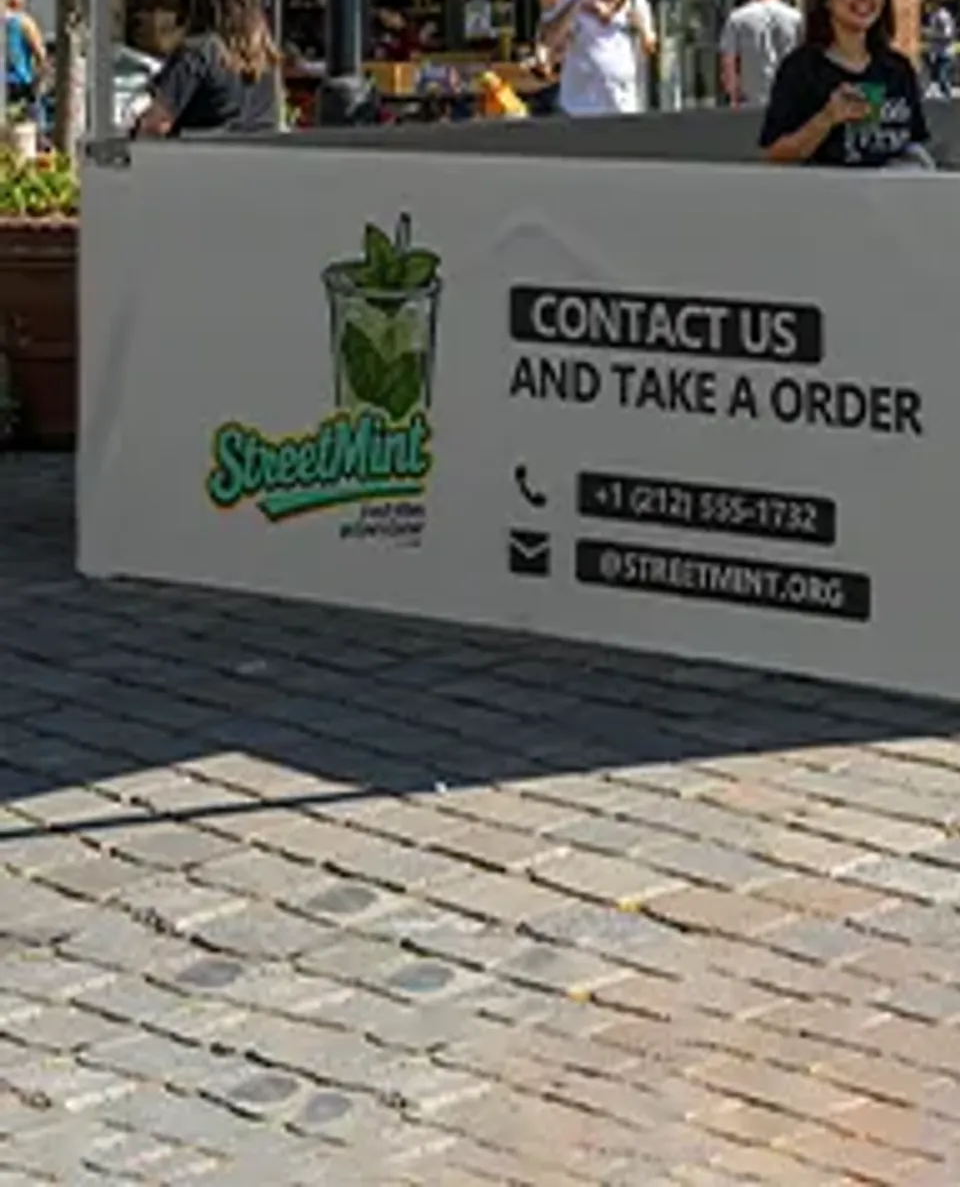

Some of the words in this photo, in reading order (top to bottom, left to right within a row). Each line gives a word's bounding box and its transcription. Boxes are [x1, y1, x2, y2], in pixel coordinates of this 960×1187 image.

[531, 295, 729, 349] CONTACT
[739, 310, 798, 355] US
[509, 356, 602, 403] AND
[611, 364, 717, 414] TAKE
[727, 376, 758, 419] A
[769, 378, 922, 436] ORDER
[207, 412, 431, 507] StreetMint
[594, 481, 622, 507] +1
[630, 486, 692, 521] (212)
[700, 494, 817, 532] 555-1732
[601, 550, 844, 608] @STREETMINT.ORG
